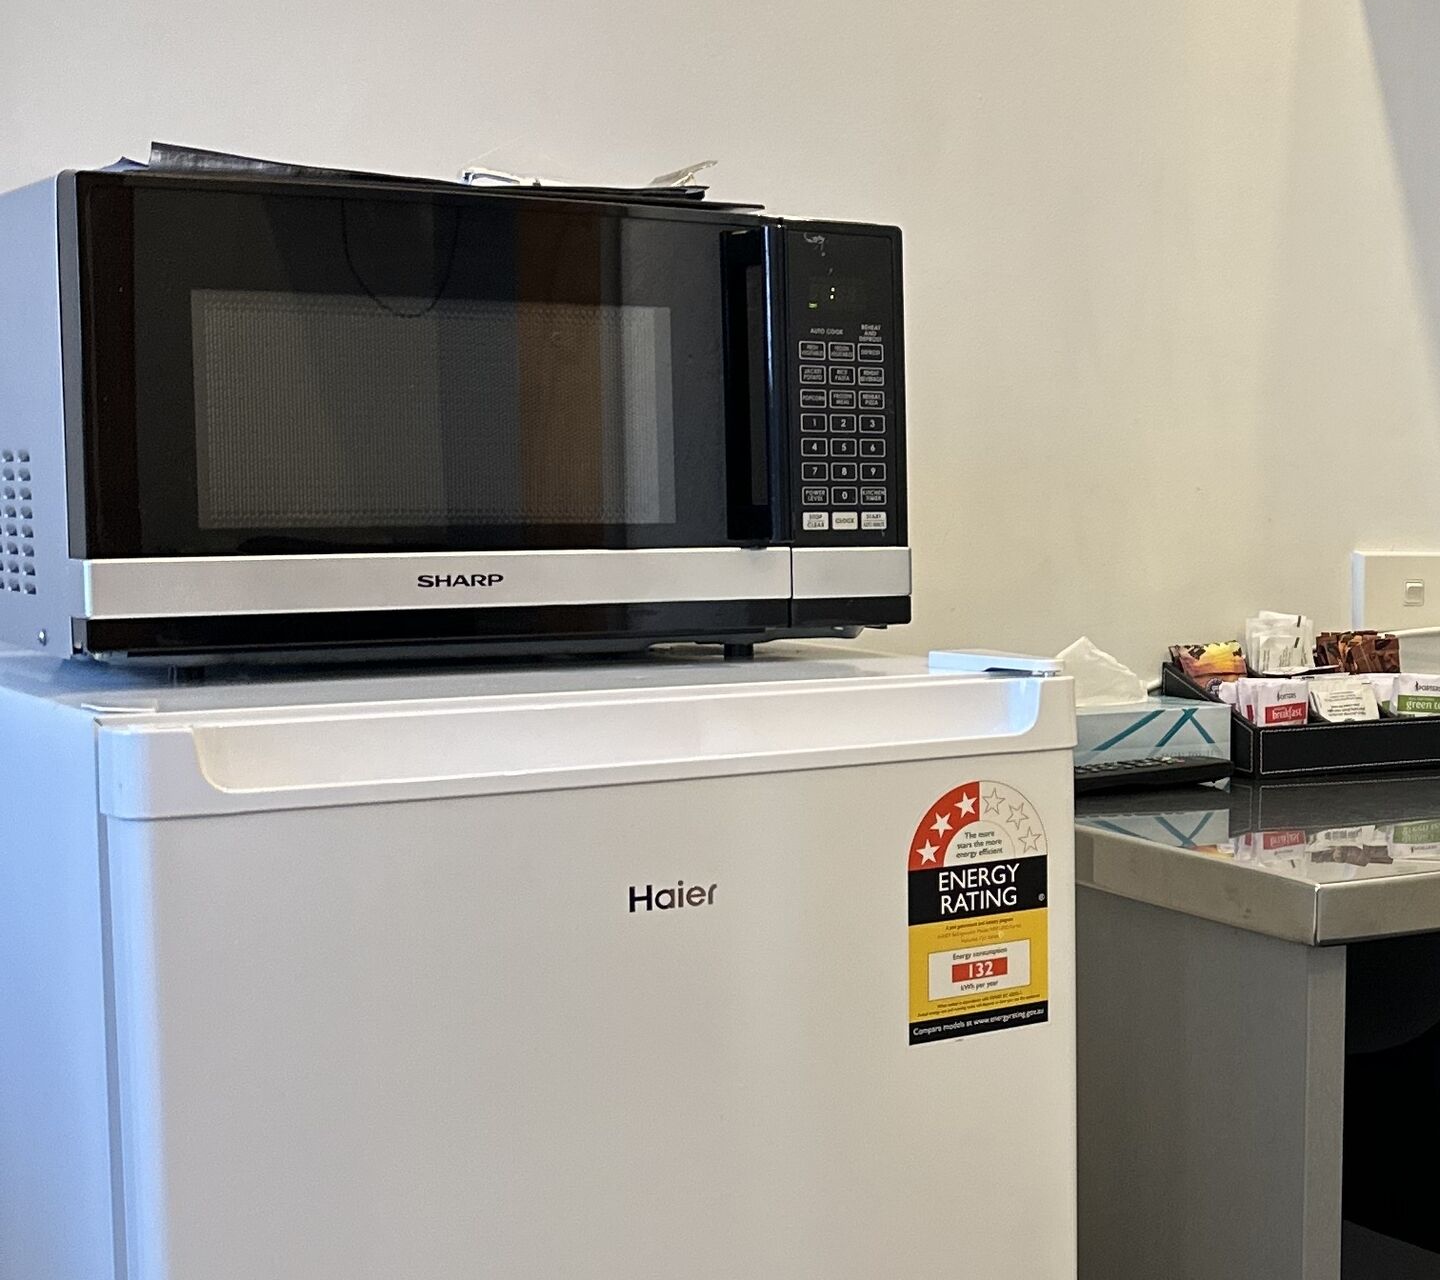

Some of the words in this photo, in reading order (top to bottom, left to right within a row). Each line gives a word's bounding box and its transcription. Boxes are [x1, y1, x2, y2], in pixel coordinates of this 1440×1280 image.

[813, 418, 817, 427] 1
[840, 419, 847, 428] 2
[869, 419, 876, 428] 3
[811, 442, 818, 451] 4
[841, 442, 847, 451] 5
[870, 444, 876, 452] 6
[812, 466, 818, 476] 7
[841, 467, 847, 476] 8
[870, 467, 876, 476] 9
[842, 491, 848, 500] 0
[417, 574, 504, 588] SHARP
[1406, 701, 1433, 710] green
[1272, 706, 1303, 720] breakfast
[978, 848, 1003, 856] efficient
[939, 863, 1020, 892] ENERGY
[629, 880, 717, 913] Haier
[941, 886, 1018, 915] RATING
[953, 953, 972, 961] Energy
[972, 947, 1008, 958] consumption
[968, 961, 994, 979] 132
[975, 982, 986, 990] per
[986, 980, 999, 989] year
[912, 1025, 942, 1036] Compare
[943, 1021, 966, 1032] models
[973, 1008, 1045, 1025] www.energyrating.gov.au
